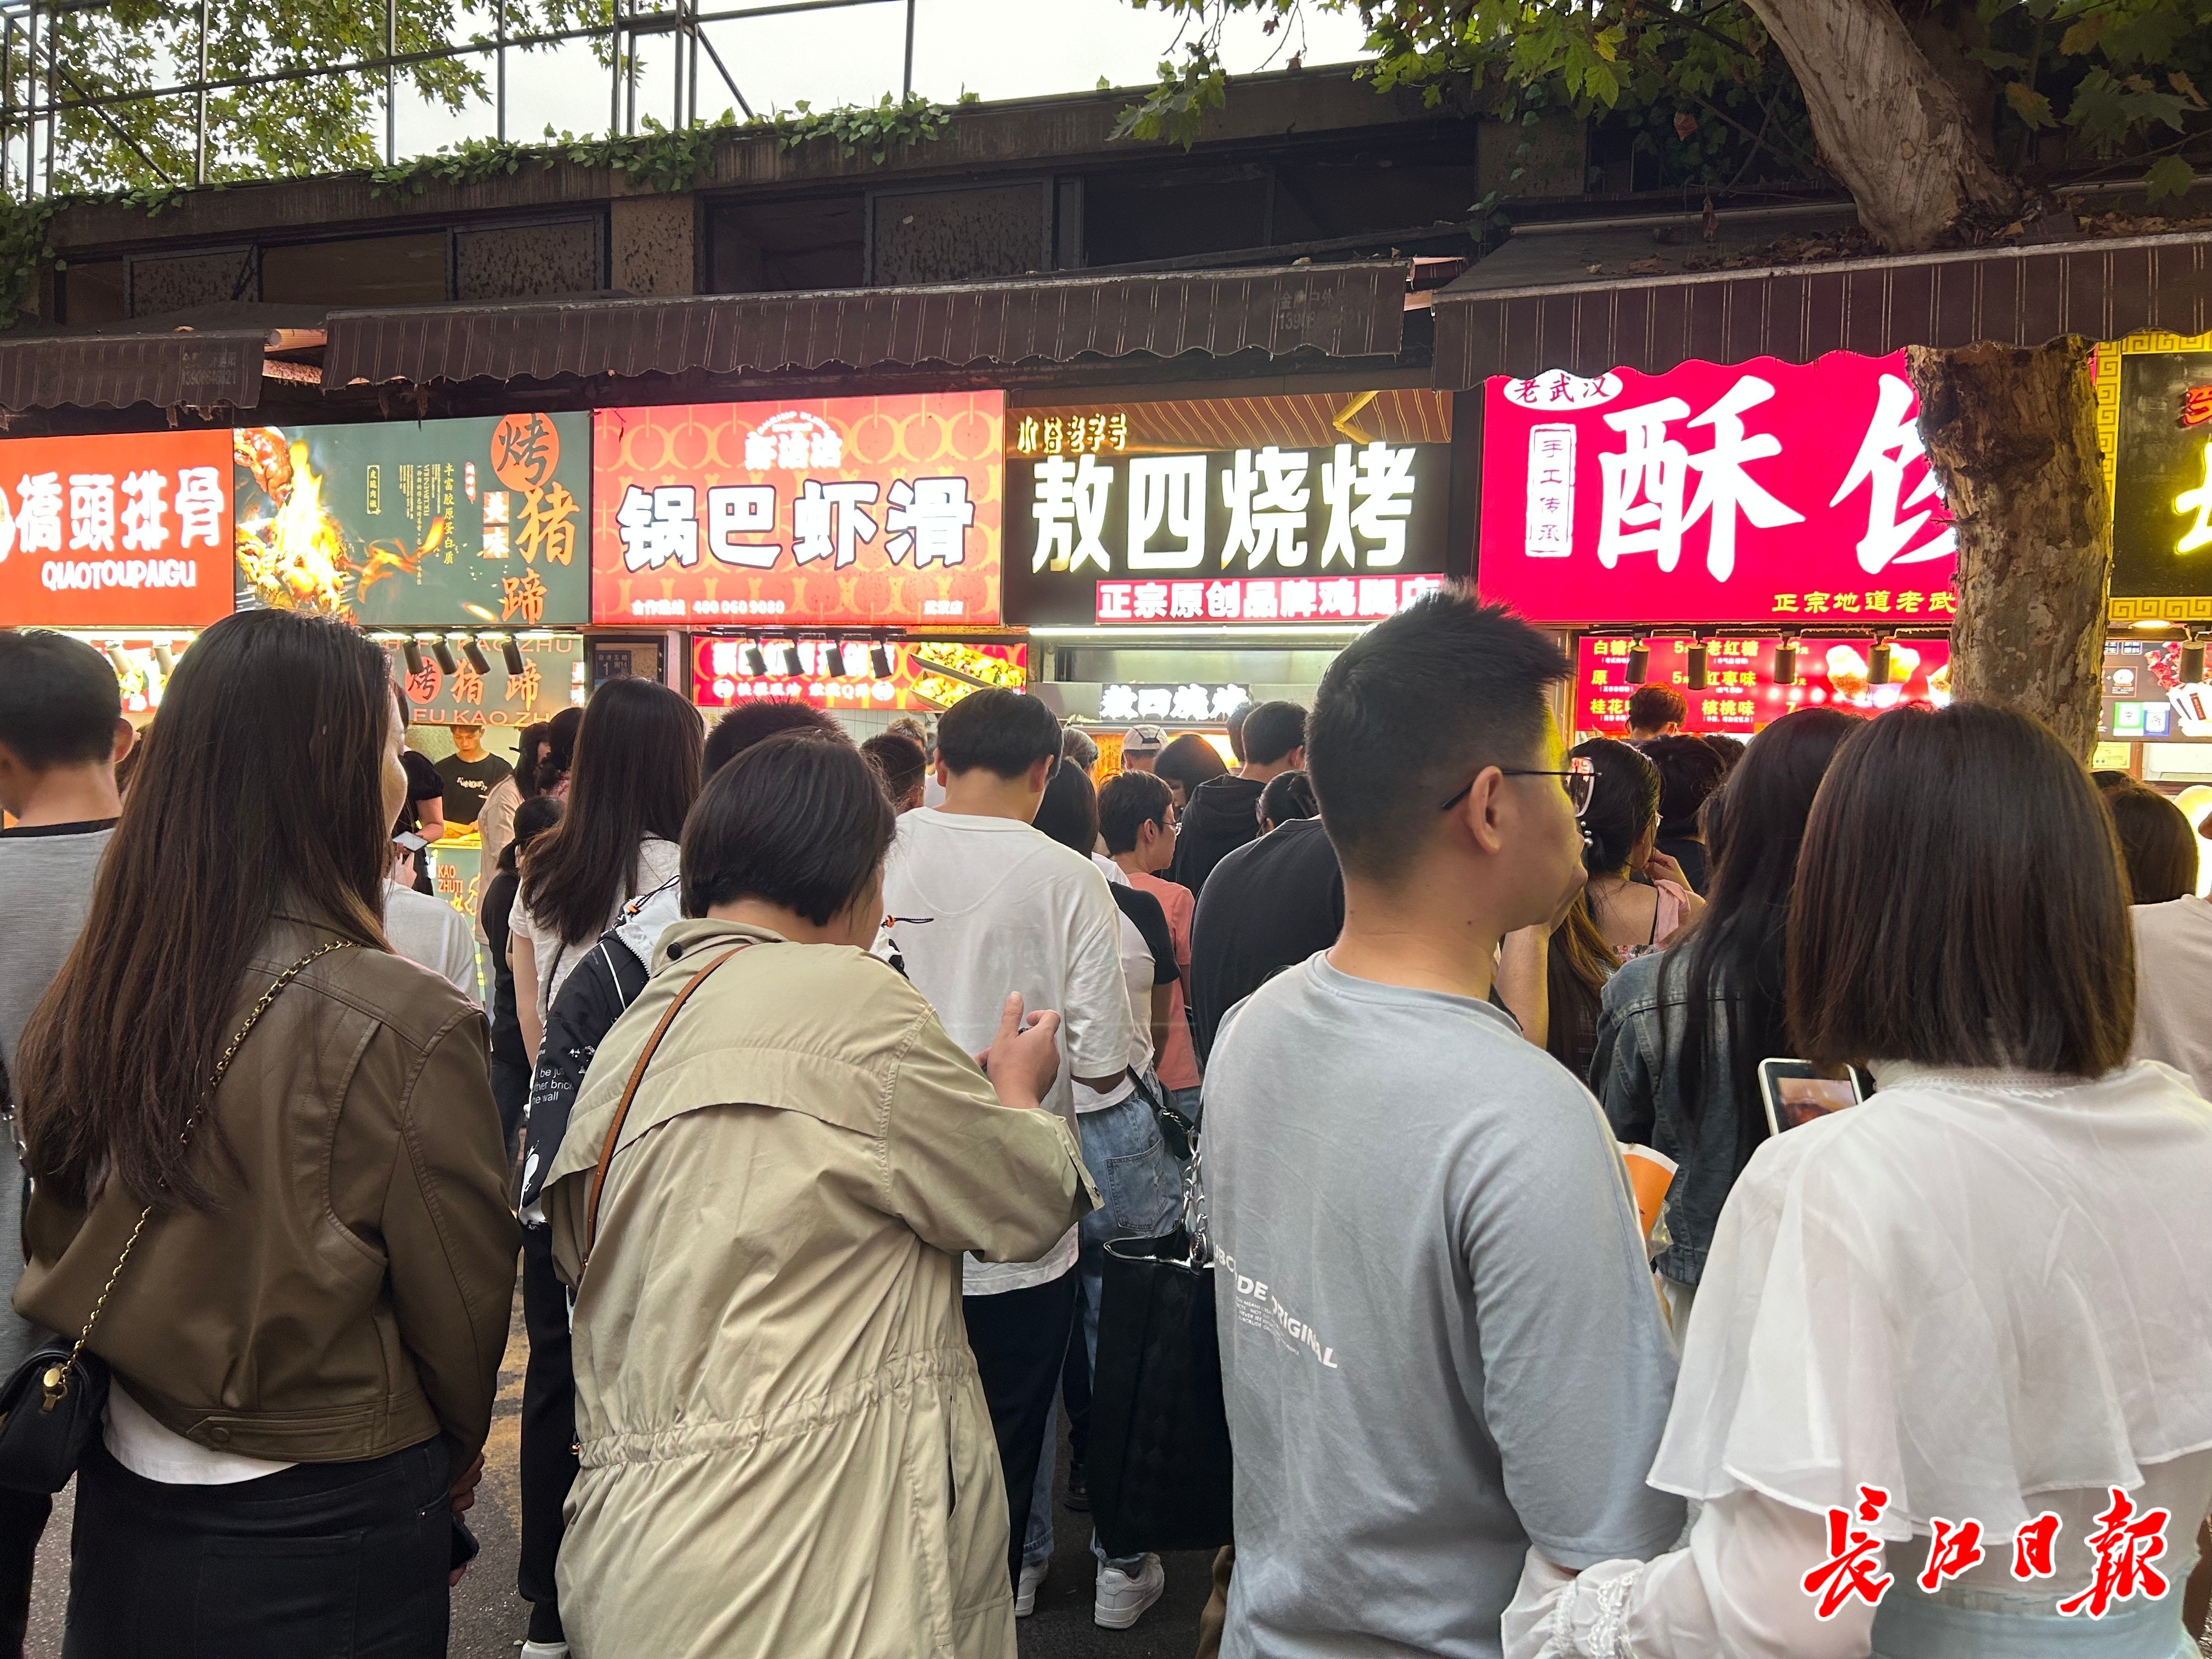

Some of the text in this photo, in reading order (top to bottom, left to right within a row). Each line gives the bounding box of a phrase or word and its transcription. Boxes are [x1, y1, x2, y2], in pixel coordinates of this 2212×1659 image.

[1514, 374, 1611, 402] 老武汉
[1538, 440, 1564, 543] 手工传承
[15, 466, 224, 552] 橋頭排骨
[443, 462, 455, 564] 丰富胶原蛋白质
[1032, 441, 1417, 574] 敖四烧烤
[497, 420, 579, 625] 烤猪蹄
[617, 477, 974, 571] 锅巴虾滑
[41, 559, 196, 591] QIAOTOUPAIGU
[1707, 640, 1758, 656] 老红糖
[1707, 671, 1756, 687] 红枣味
[454, 709, 508, 726] KAO
[515, 712, 550, 726] ZH
[1702, 699, 1754, 716] 核桃味
[438, 865, 455, 879] KAO
[437, 879, 463, 894] ZHUTI
[540, 1068, 551, 1078] be
[542, 1091, 559, 1103] wall
